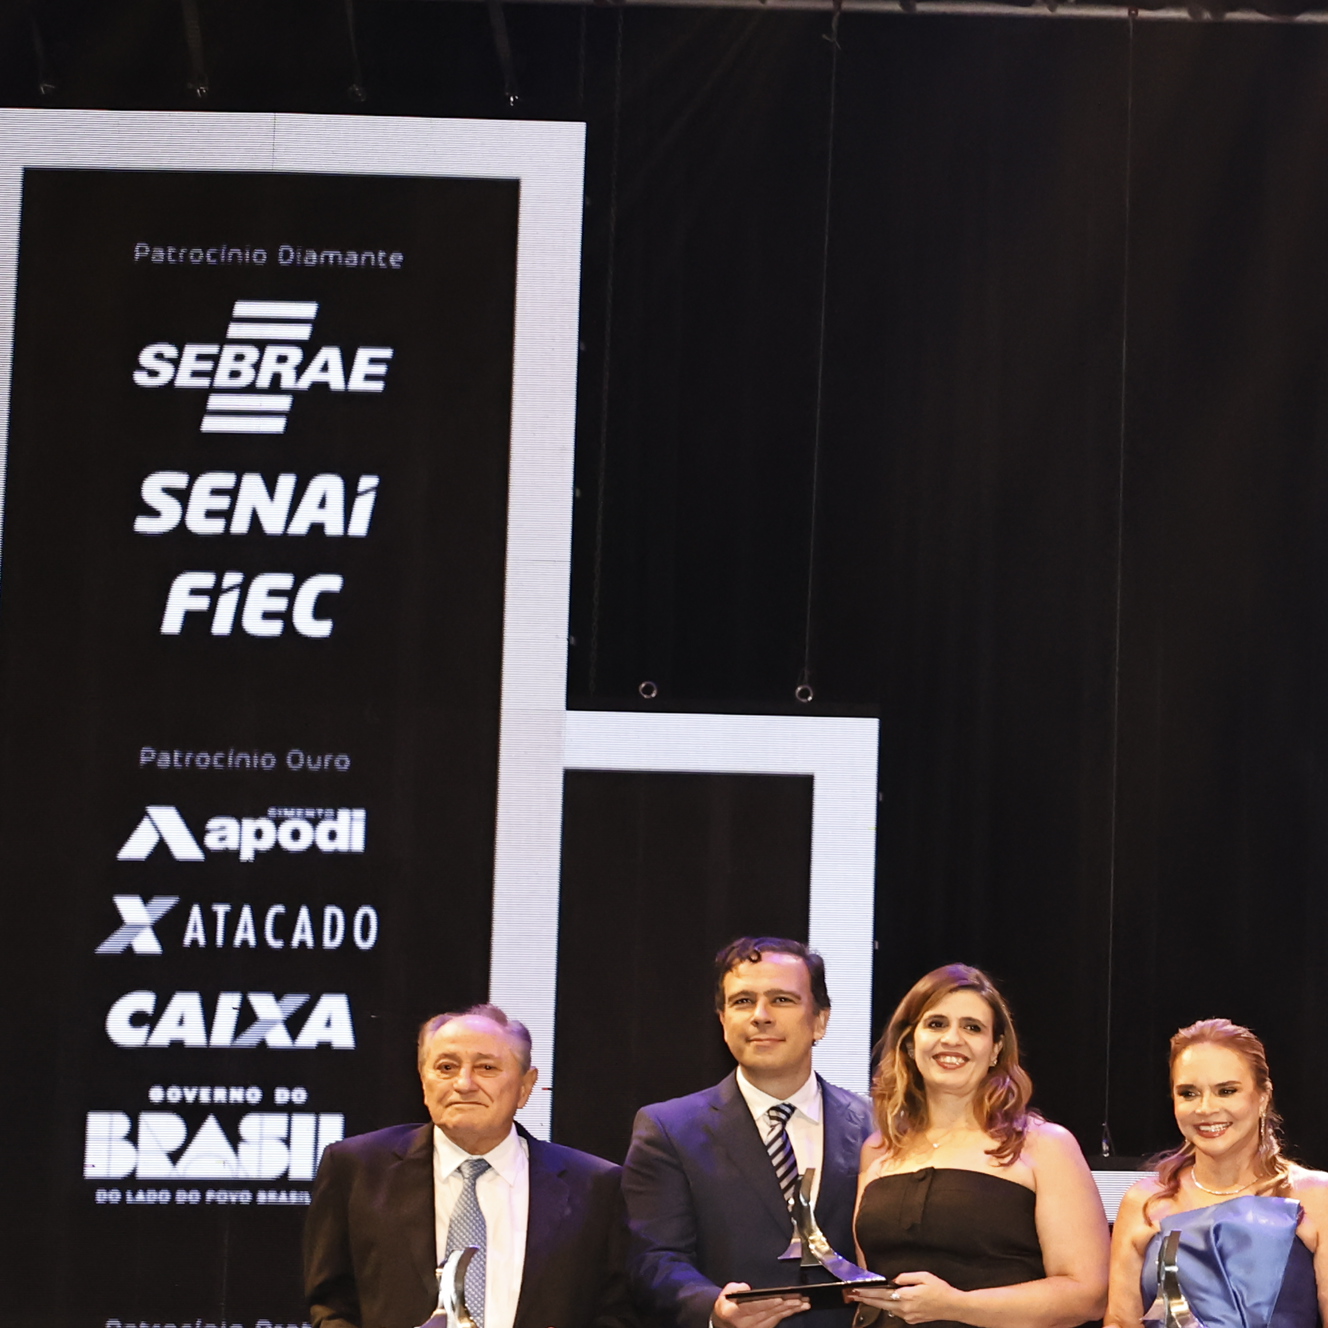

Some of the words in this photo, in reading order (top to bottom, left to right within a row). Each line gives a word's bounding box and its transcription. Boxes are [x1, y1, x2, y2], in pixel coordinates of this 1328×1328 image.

[133, 242, 268, 266] Patrocínio
[277, 244, 404, 269] Diamante
[132, 343, 394, 393] SEBRAE
[139, 746, 277, 771] Patrocínio
[285, 748, 351, 772] Ouro
[203, 807, 367, 863] apodi
[183, 903, 378, 950] ATACADO
[105, 991, 356, 1050] CAIXA
[148, 1085, 263, 1104] GOVERNO
[274, 1086, 308, 1105] DO
[95, 1189, 122, 1204] DO
[125, 1189, 172, 1205] LADO
[174, 1189, 202, 1205] DO
[205, 1189, 253, 1205] POVO
